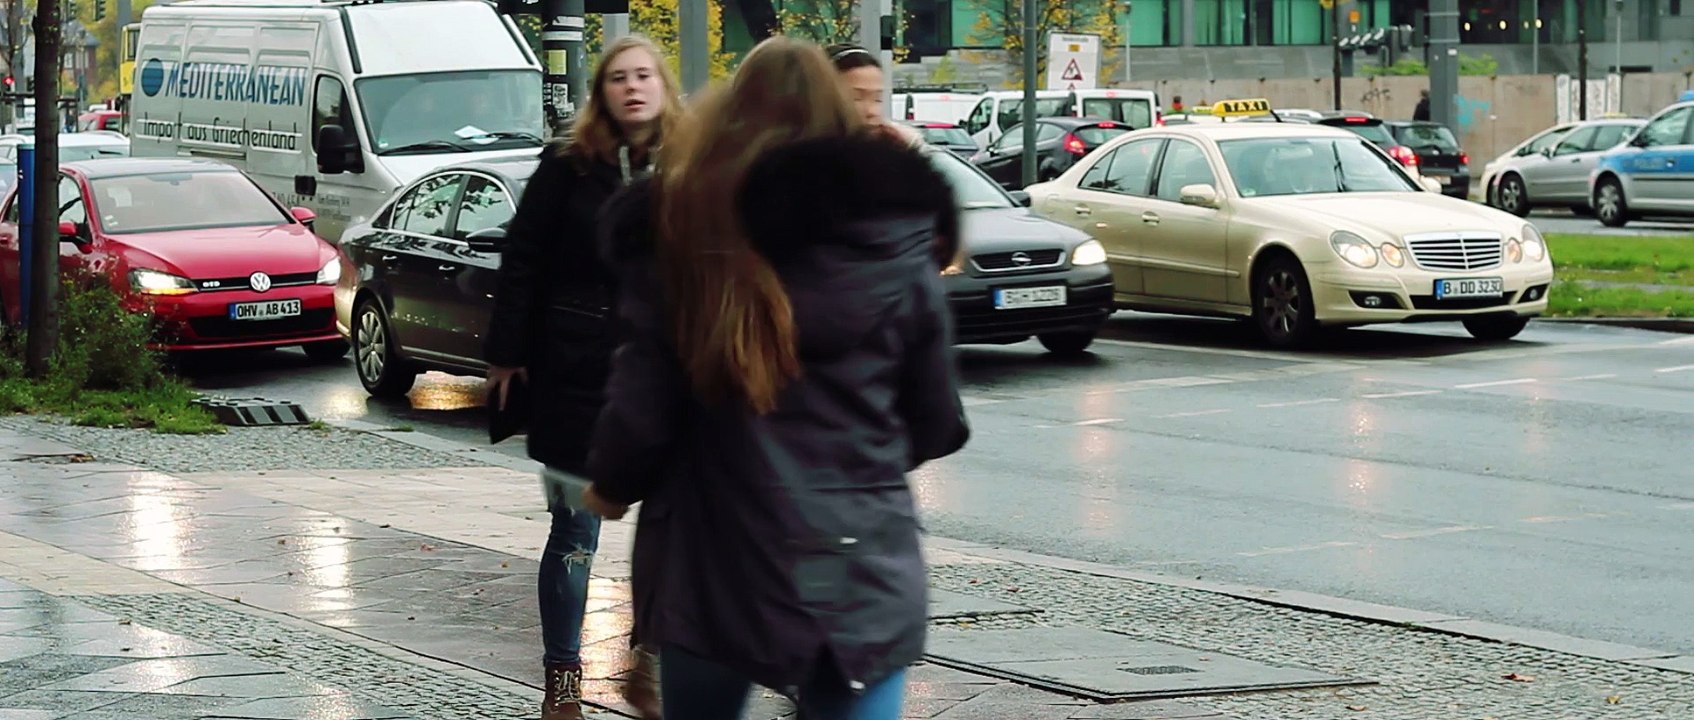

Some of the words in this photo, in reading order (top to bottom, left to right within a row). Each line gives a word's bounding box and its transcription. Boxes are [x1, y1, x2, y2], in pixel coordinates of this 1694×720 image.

[165, 62, 307, 107] MEDITERRANEAN
[1226, 101, 1264, 112] TAXI
[187, 123, 207, 142] aus
[212, 117, 297, 150] Griechenland
[1443, 282, 1452, 295] B
[1460, 281, 1476, 294] DD
[236, 305, 258, 318] OHV
[266, 303, 279, 316] AB
[280, 301, 299, 315] 413
